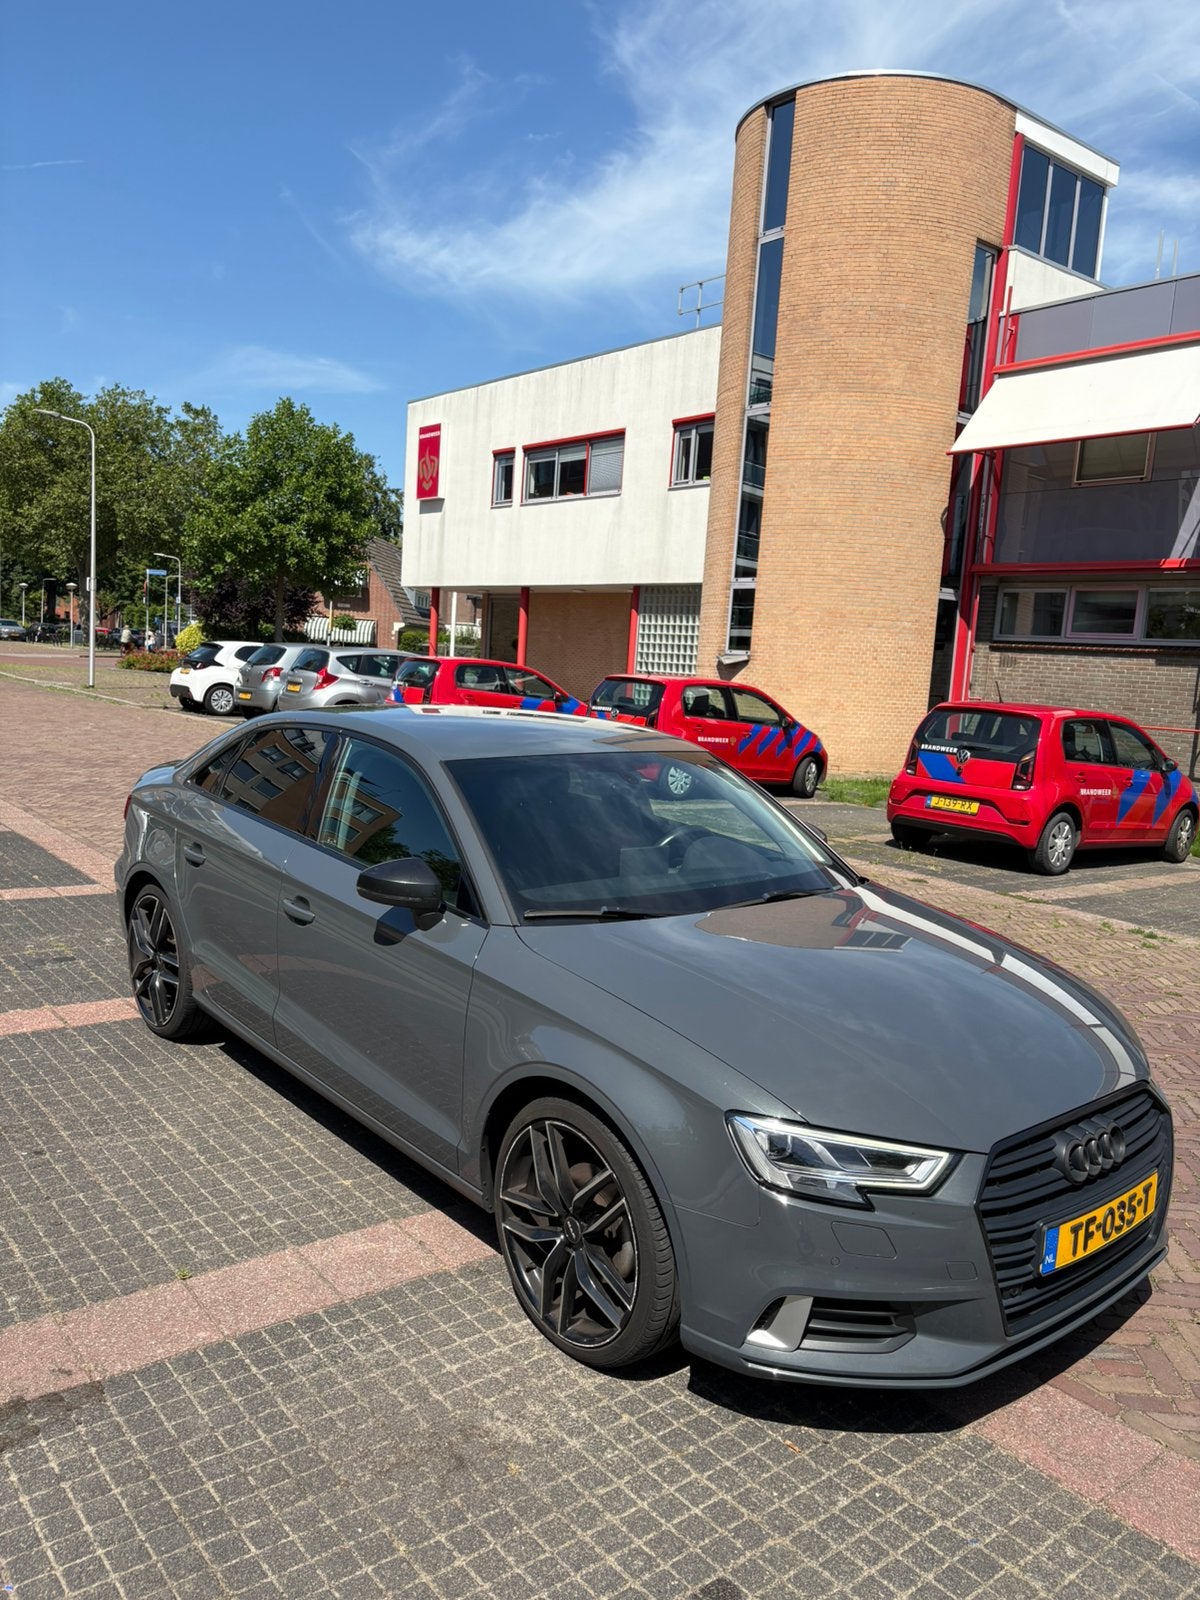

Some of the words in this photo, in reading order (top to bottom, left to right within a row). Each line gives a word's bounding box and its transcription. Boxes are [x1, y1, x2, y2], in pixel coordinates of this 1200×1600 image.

[920, 743, 958, 753] BRANDWEER
[1080, 788, 1112, 796] BRANDWEER
[934, 797, 972, 810] J-139-RX
[1070, 1182, 1152, 1257] TF-035-T
[1044, 1254, 1055, 1264] NL
